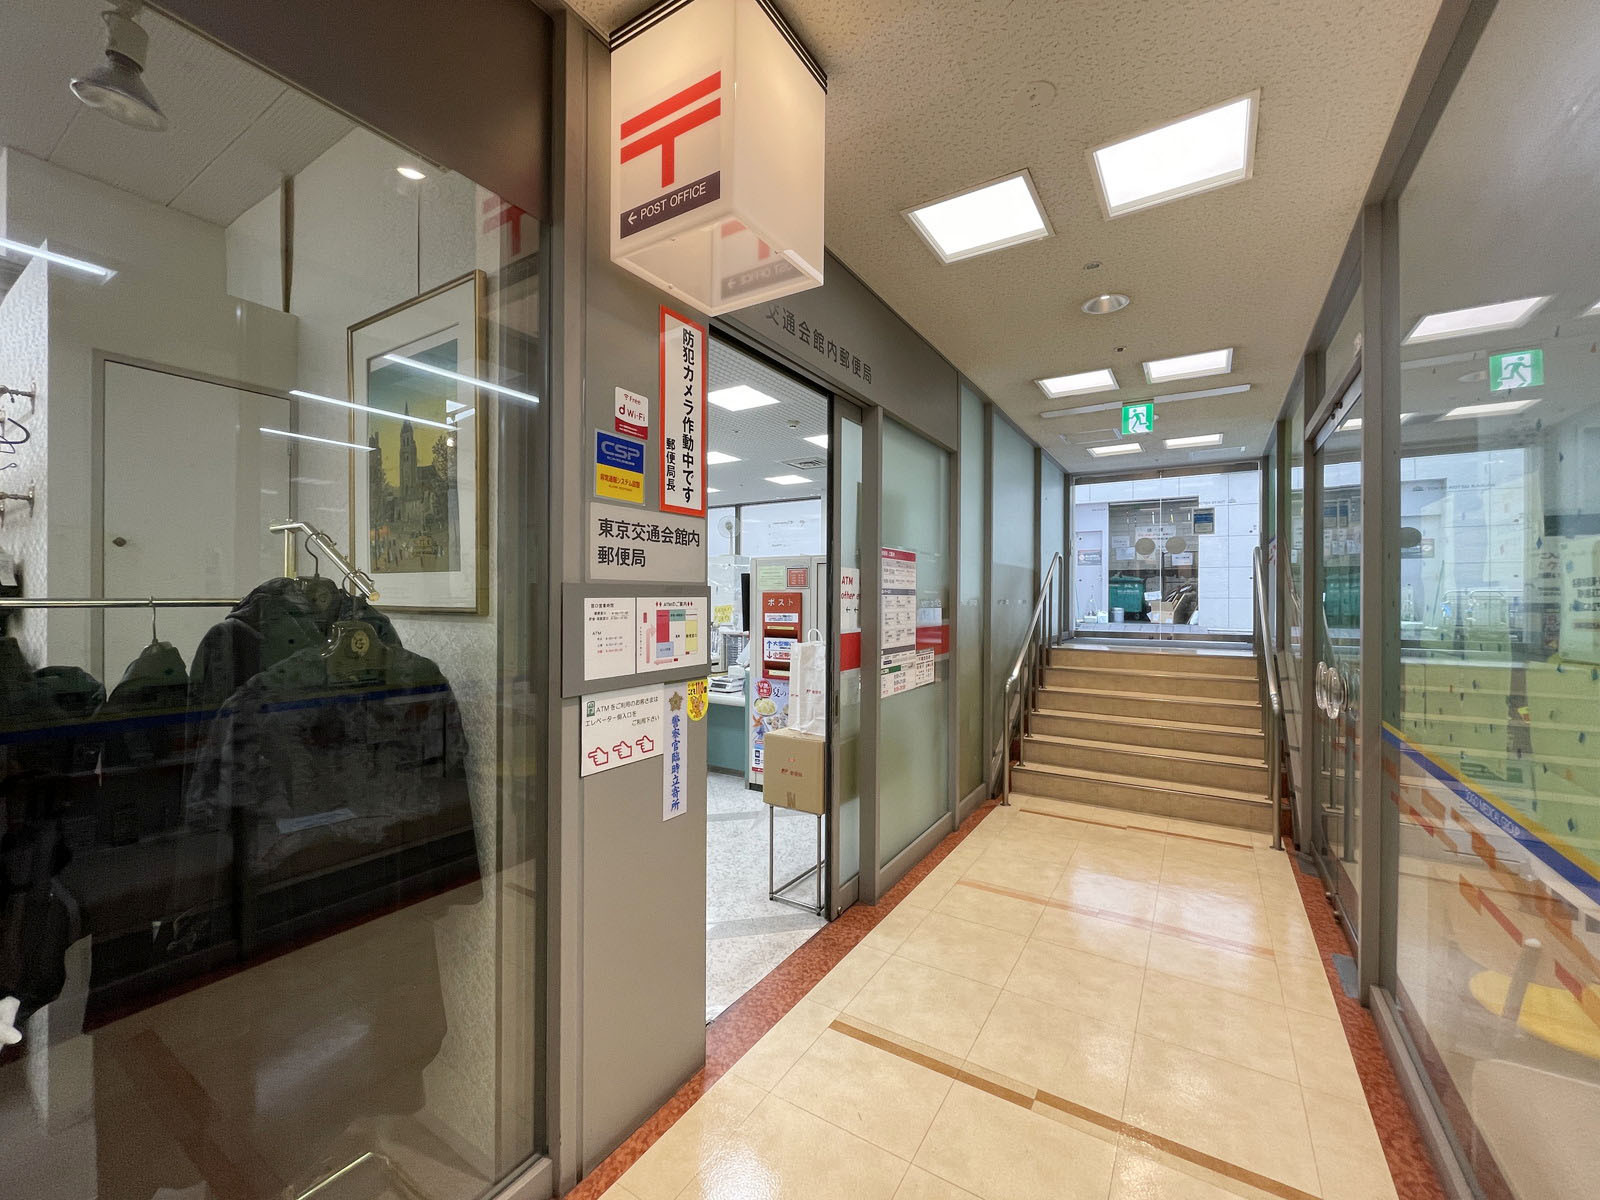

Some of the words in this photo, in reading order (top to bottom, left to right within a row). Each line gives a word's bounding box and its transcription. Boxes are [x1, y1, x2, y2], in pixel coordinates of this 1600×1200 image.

[640, 199, 667, 220] POST
[669, 181, 707, 207] OFFICE
[629, 395, 641, 405] Free
[682, 327, 695, 504] 防犯カメラ作動中です
[600, 440, 641, 461] CSP
[666, 437, 676, 492] 郵便局長
[597, 518, 700, 547] 東京交通会館内
[597, 546, 646, 567] 郵便局
[842, 576, 854, 585] ATM
[767, 598, 794, 607] ポスト
